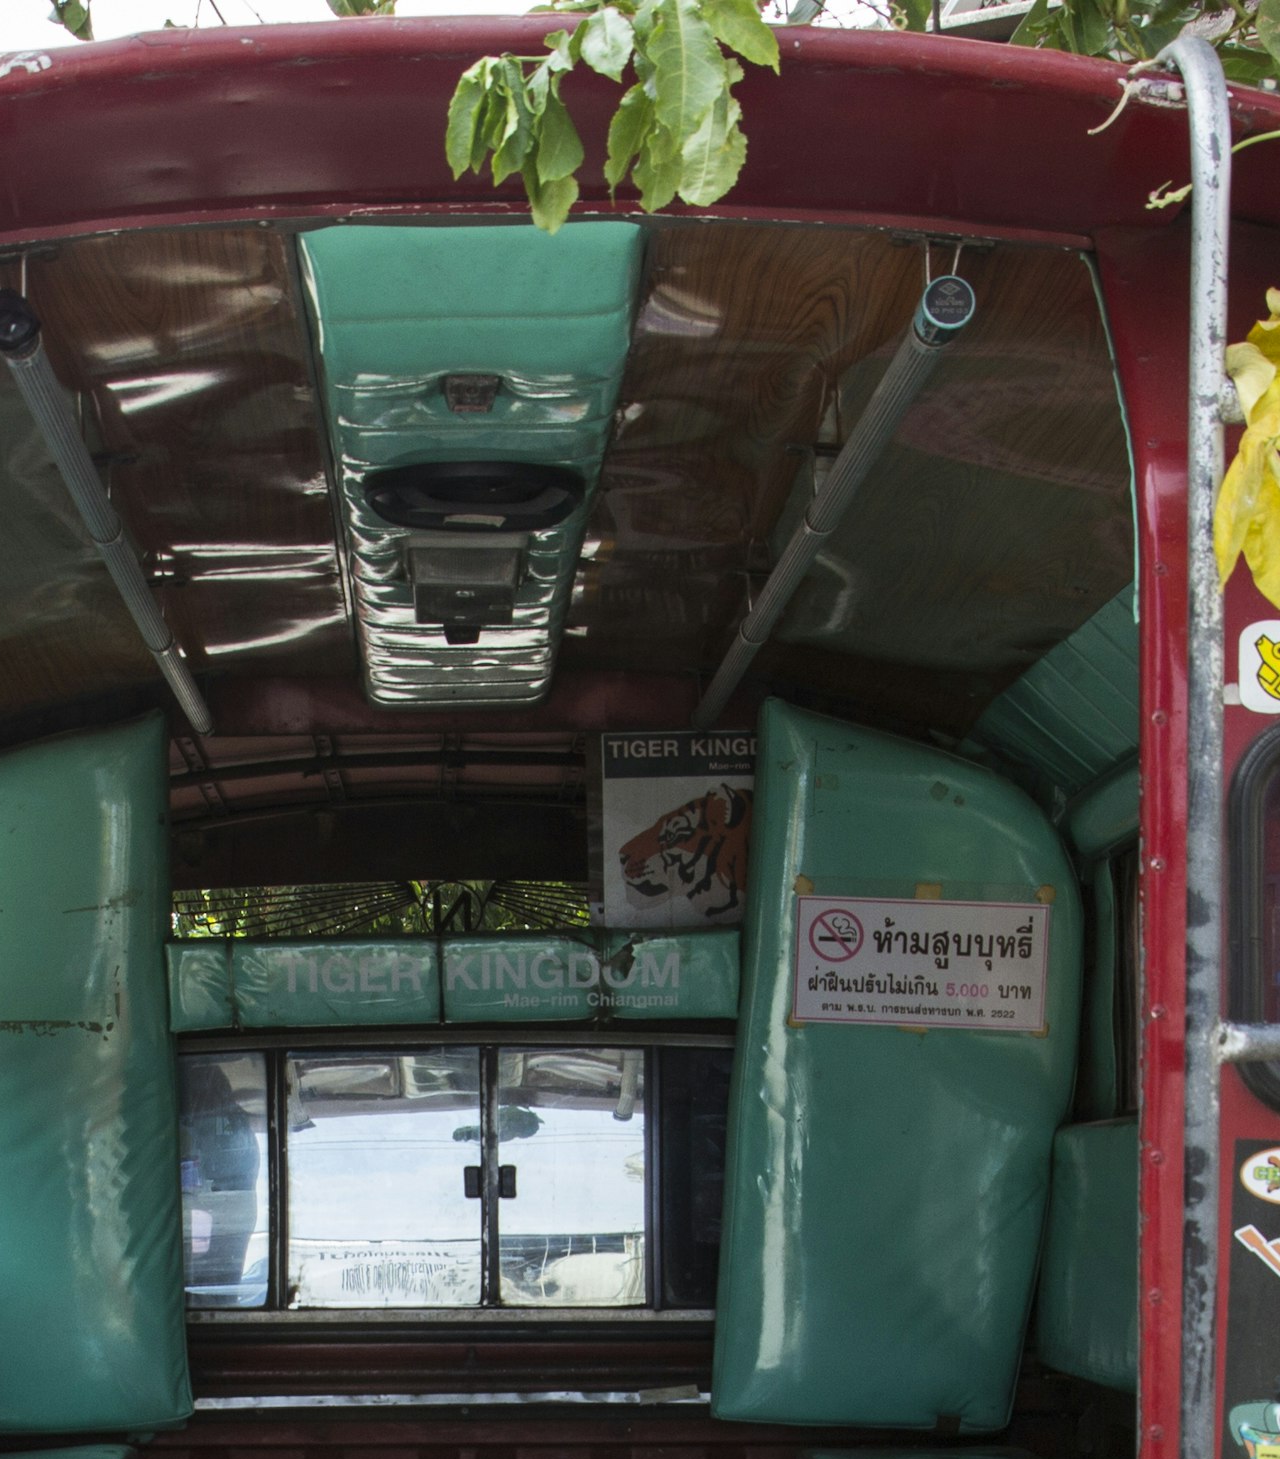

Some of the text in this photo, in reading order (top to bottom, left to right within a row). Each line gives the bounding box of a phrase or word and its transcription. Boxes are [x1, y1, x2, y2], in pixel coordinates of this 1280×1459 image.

[608, 739, 679, 759] TIGER
[873, 916, 1034, 971] ห้ามสูบบุหรี่
[278, 952, 681, 993] TIGER KINGDOM
[807, 965, 938, 997] ฝ่าฝืนปรับไม่เกิน
[998, 983, 1032, 1000] บาท
[504, 991, 679, 1008] Mae-rim Chiangmai
[821, 1002, 842, 1012] ตาม
[991, 1010, 1016, 1019] 2522
